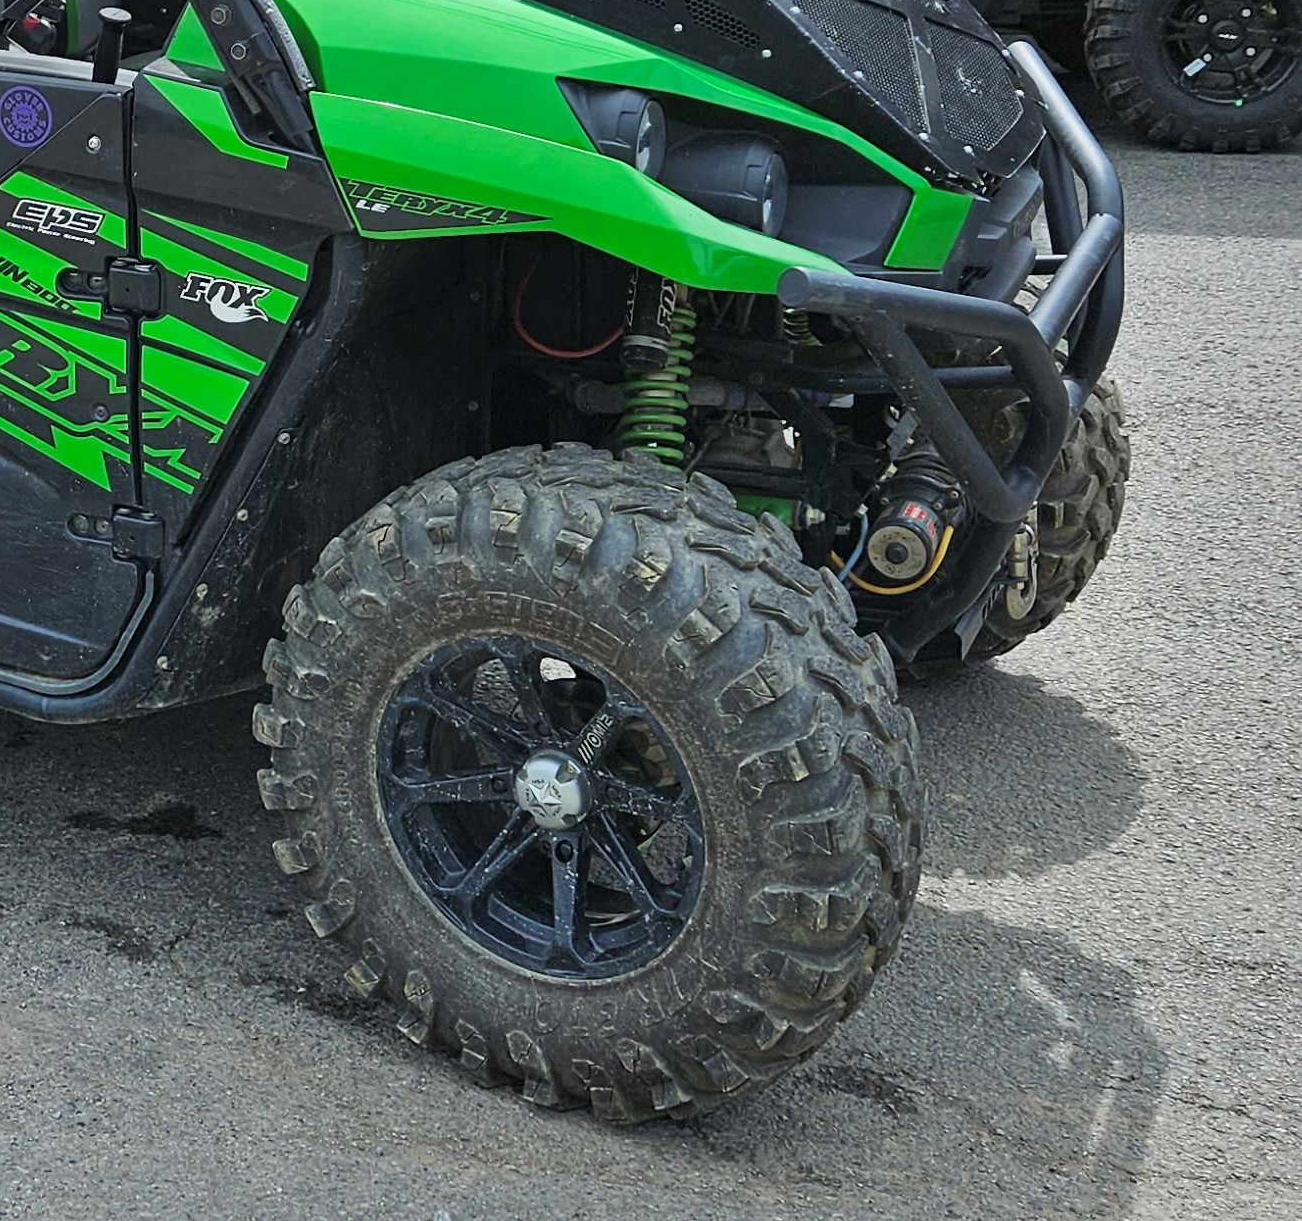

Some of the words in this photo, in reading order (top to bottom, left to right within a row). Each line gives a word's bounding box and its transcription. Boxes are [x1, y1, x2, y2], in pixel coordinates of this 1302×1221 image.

[4, 92, 44, 112] GLOVER
[3, 117, 47, 141] CUSTOMS
[348, 179, 509, 224] TERYX4
[355, 200, 391, 213] LE
[12, 199, 104, 234] EPS
[180, 272, 271, 311] FOX
